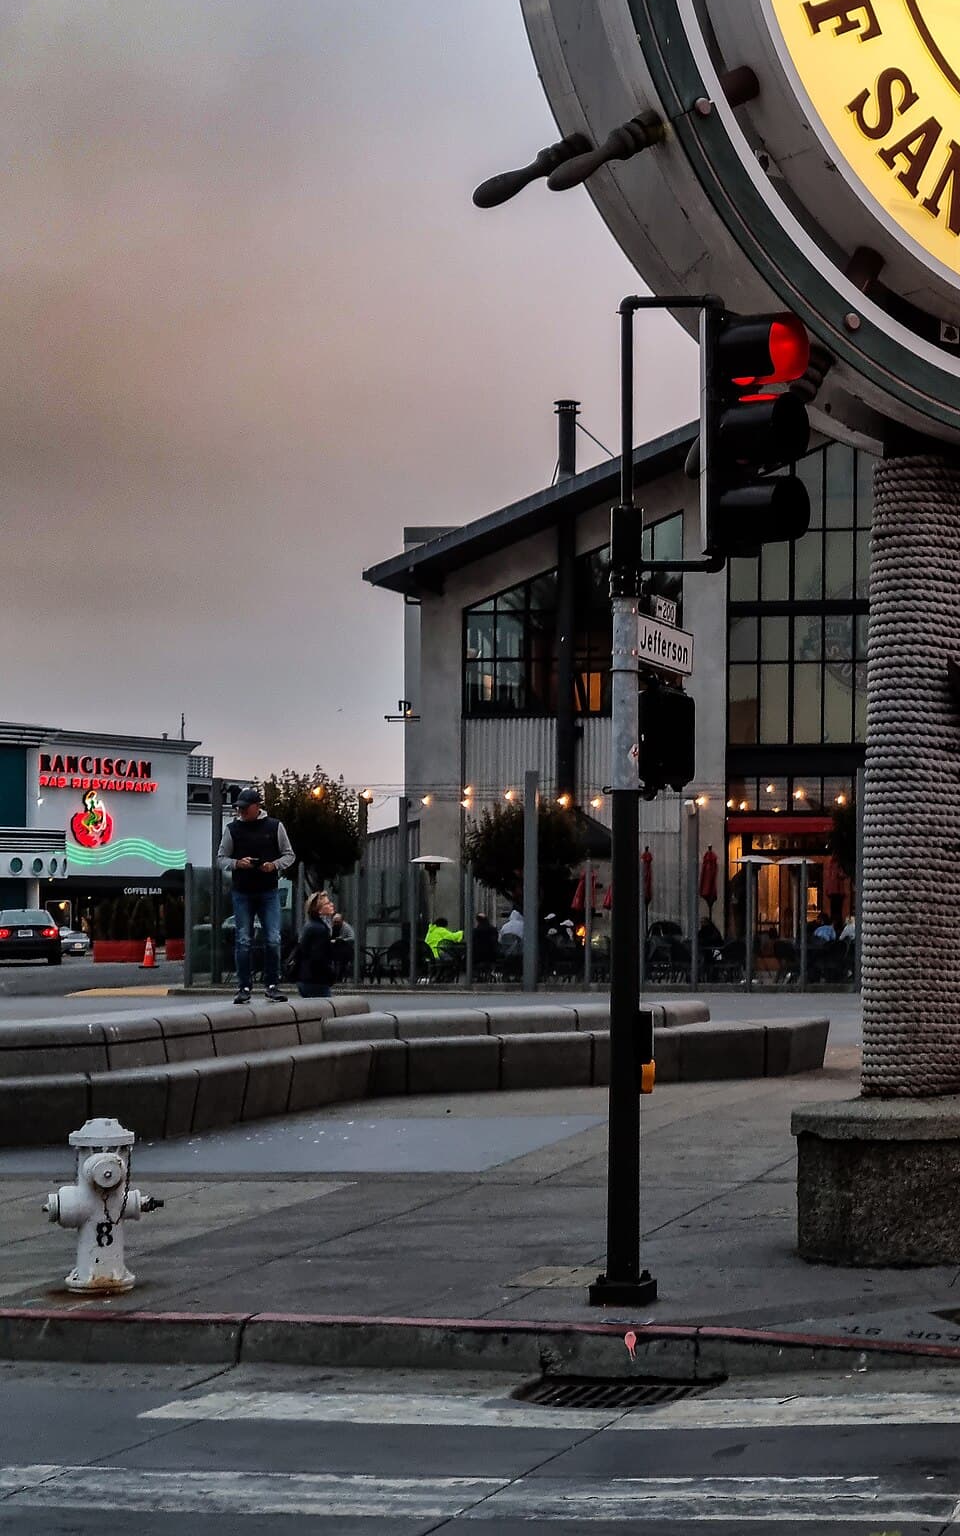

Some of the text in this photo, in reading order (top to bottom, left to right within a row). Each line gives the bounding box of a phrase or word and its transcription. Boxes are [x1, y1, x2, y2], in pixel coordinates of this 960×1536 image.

[662, 602, 675, 621] 200
[640, 625, 688, 665] Jefferson
[71, 777, 159, 793] RESTAURANT
[123, 887, 162, 895] COFFEE BAR
[96, 1221, 114, 1248] 8
